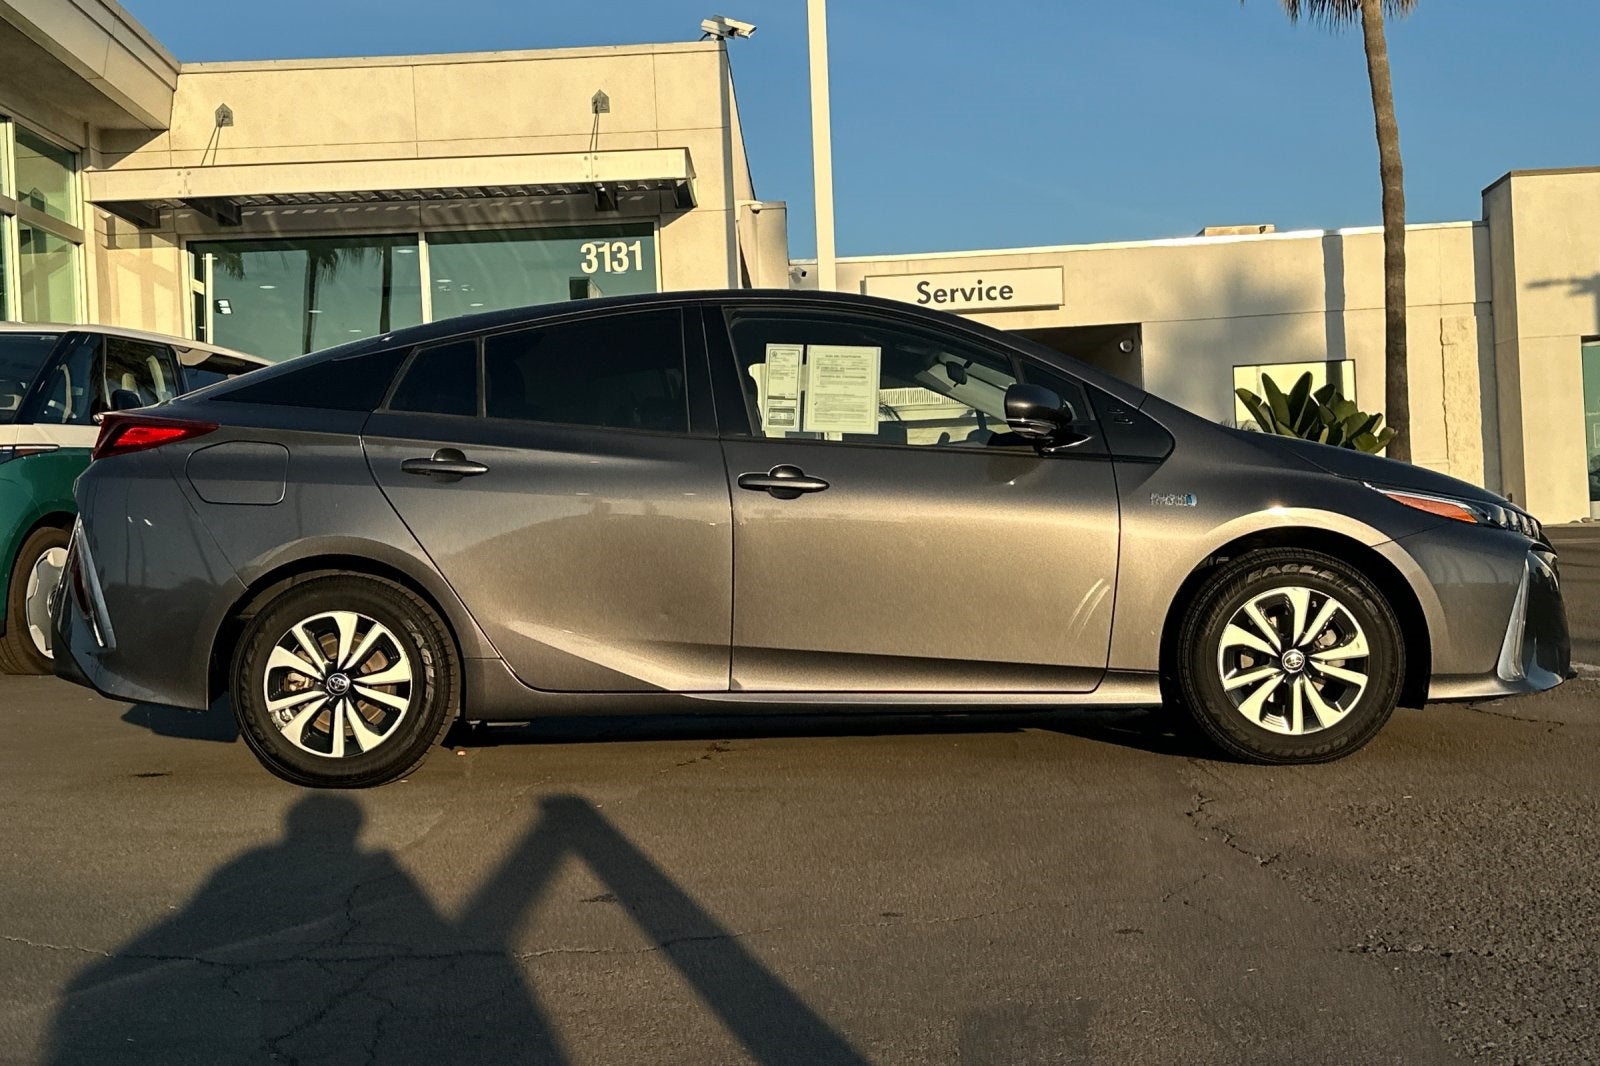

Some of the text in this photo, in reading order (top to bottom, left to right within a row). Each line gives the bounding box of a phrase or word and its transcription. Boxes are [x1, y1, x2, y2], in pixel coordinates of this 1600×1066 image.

[580, 240, 643, 274] 3131
[916, 279, 1014, 305] Service
[1246, 563, 1338, 584] EAGLE
[402, 619, 436, 702] EAGLE
